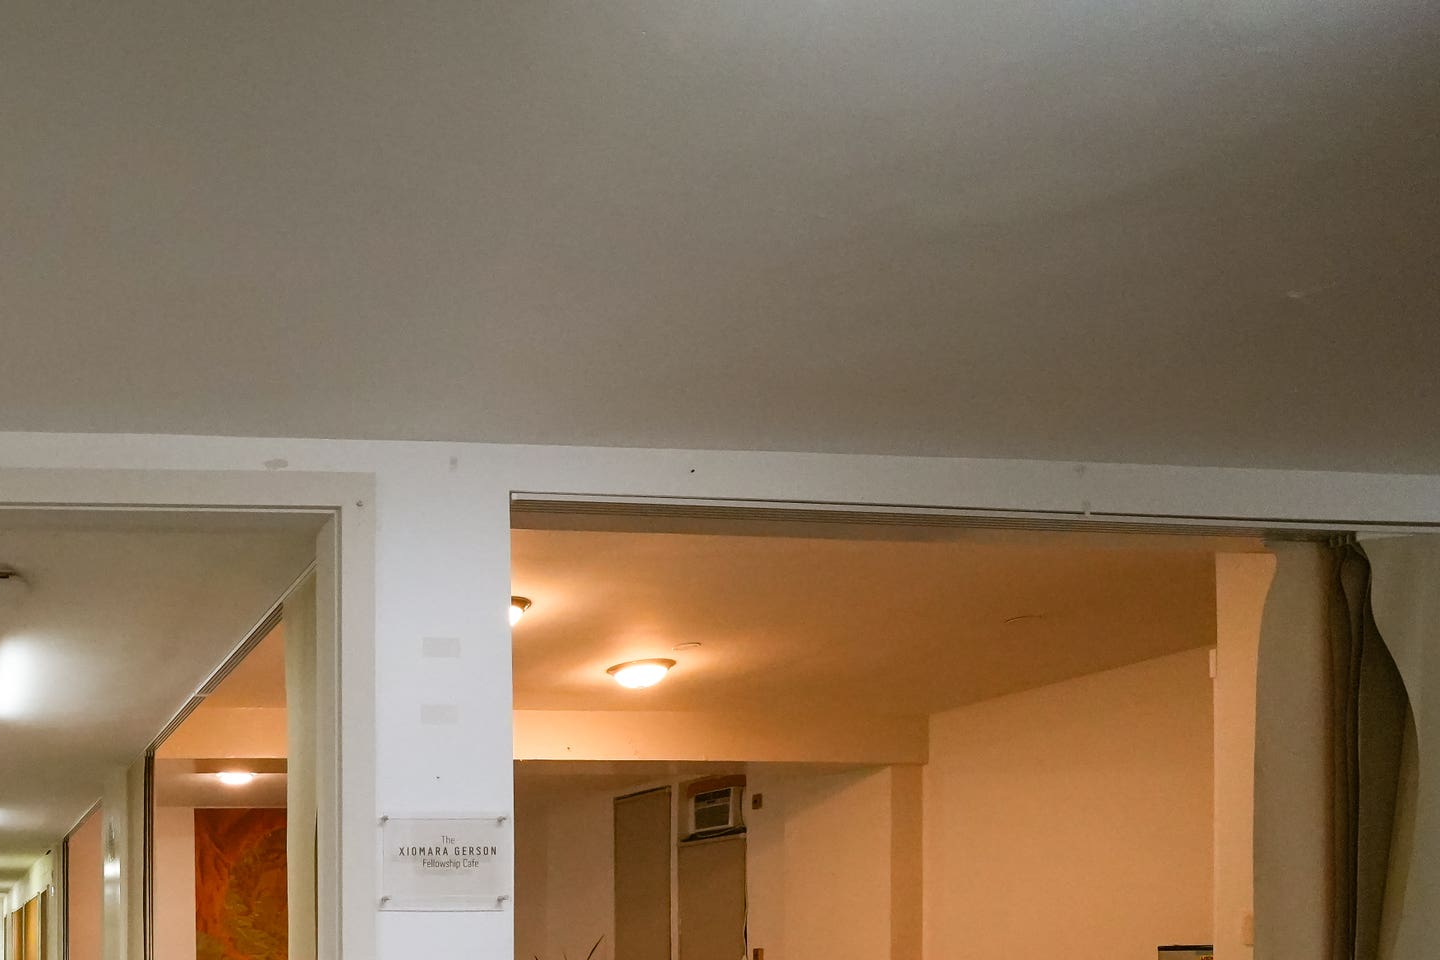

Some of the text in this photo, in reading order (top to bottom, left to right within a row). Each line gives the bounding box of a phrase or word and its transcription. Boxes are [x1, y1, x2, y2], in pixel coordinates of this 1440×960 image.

[441, 835, 455, 845] The
[399, 846, 497, 856] XIOMARA GERSON
[422, 858, 479, 869] Fellowship Cafe
